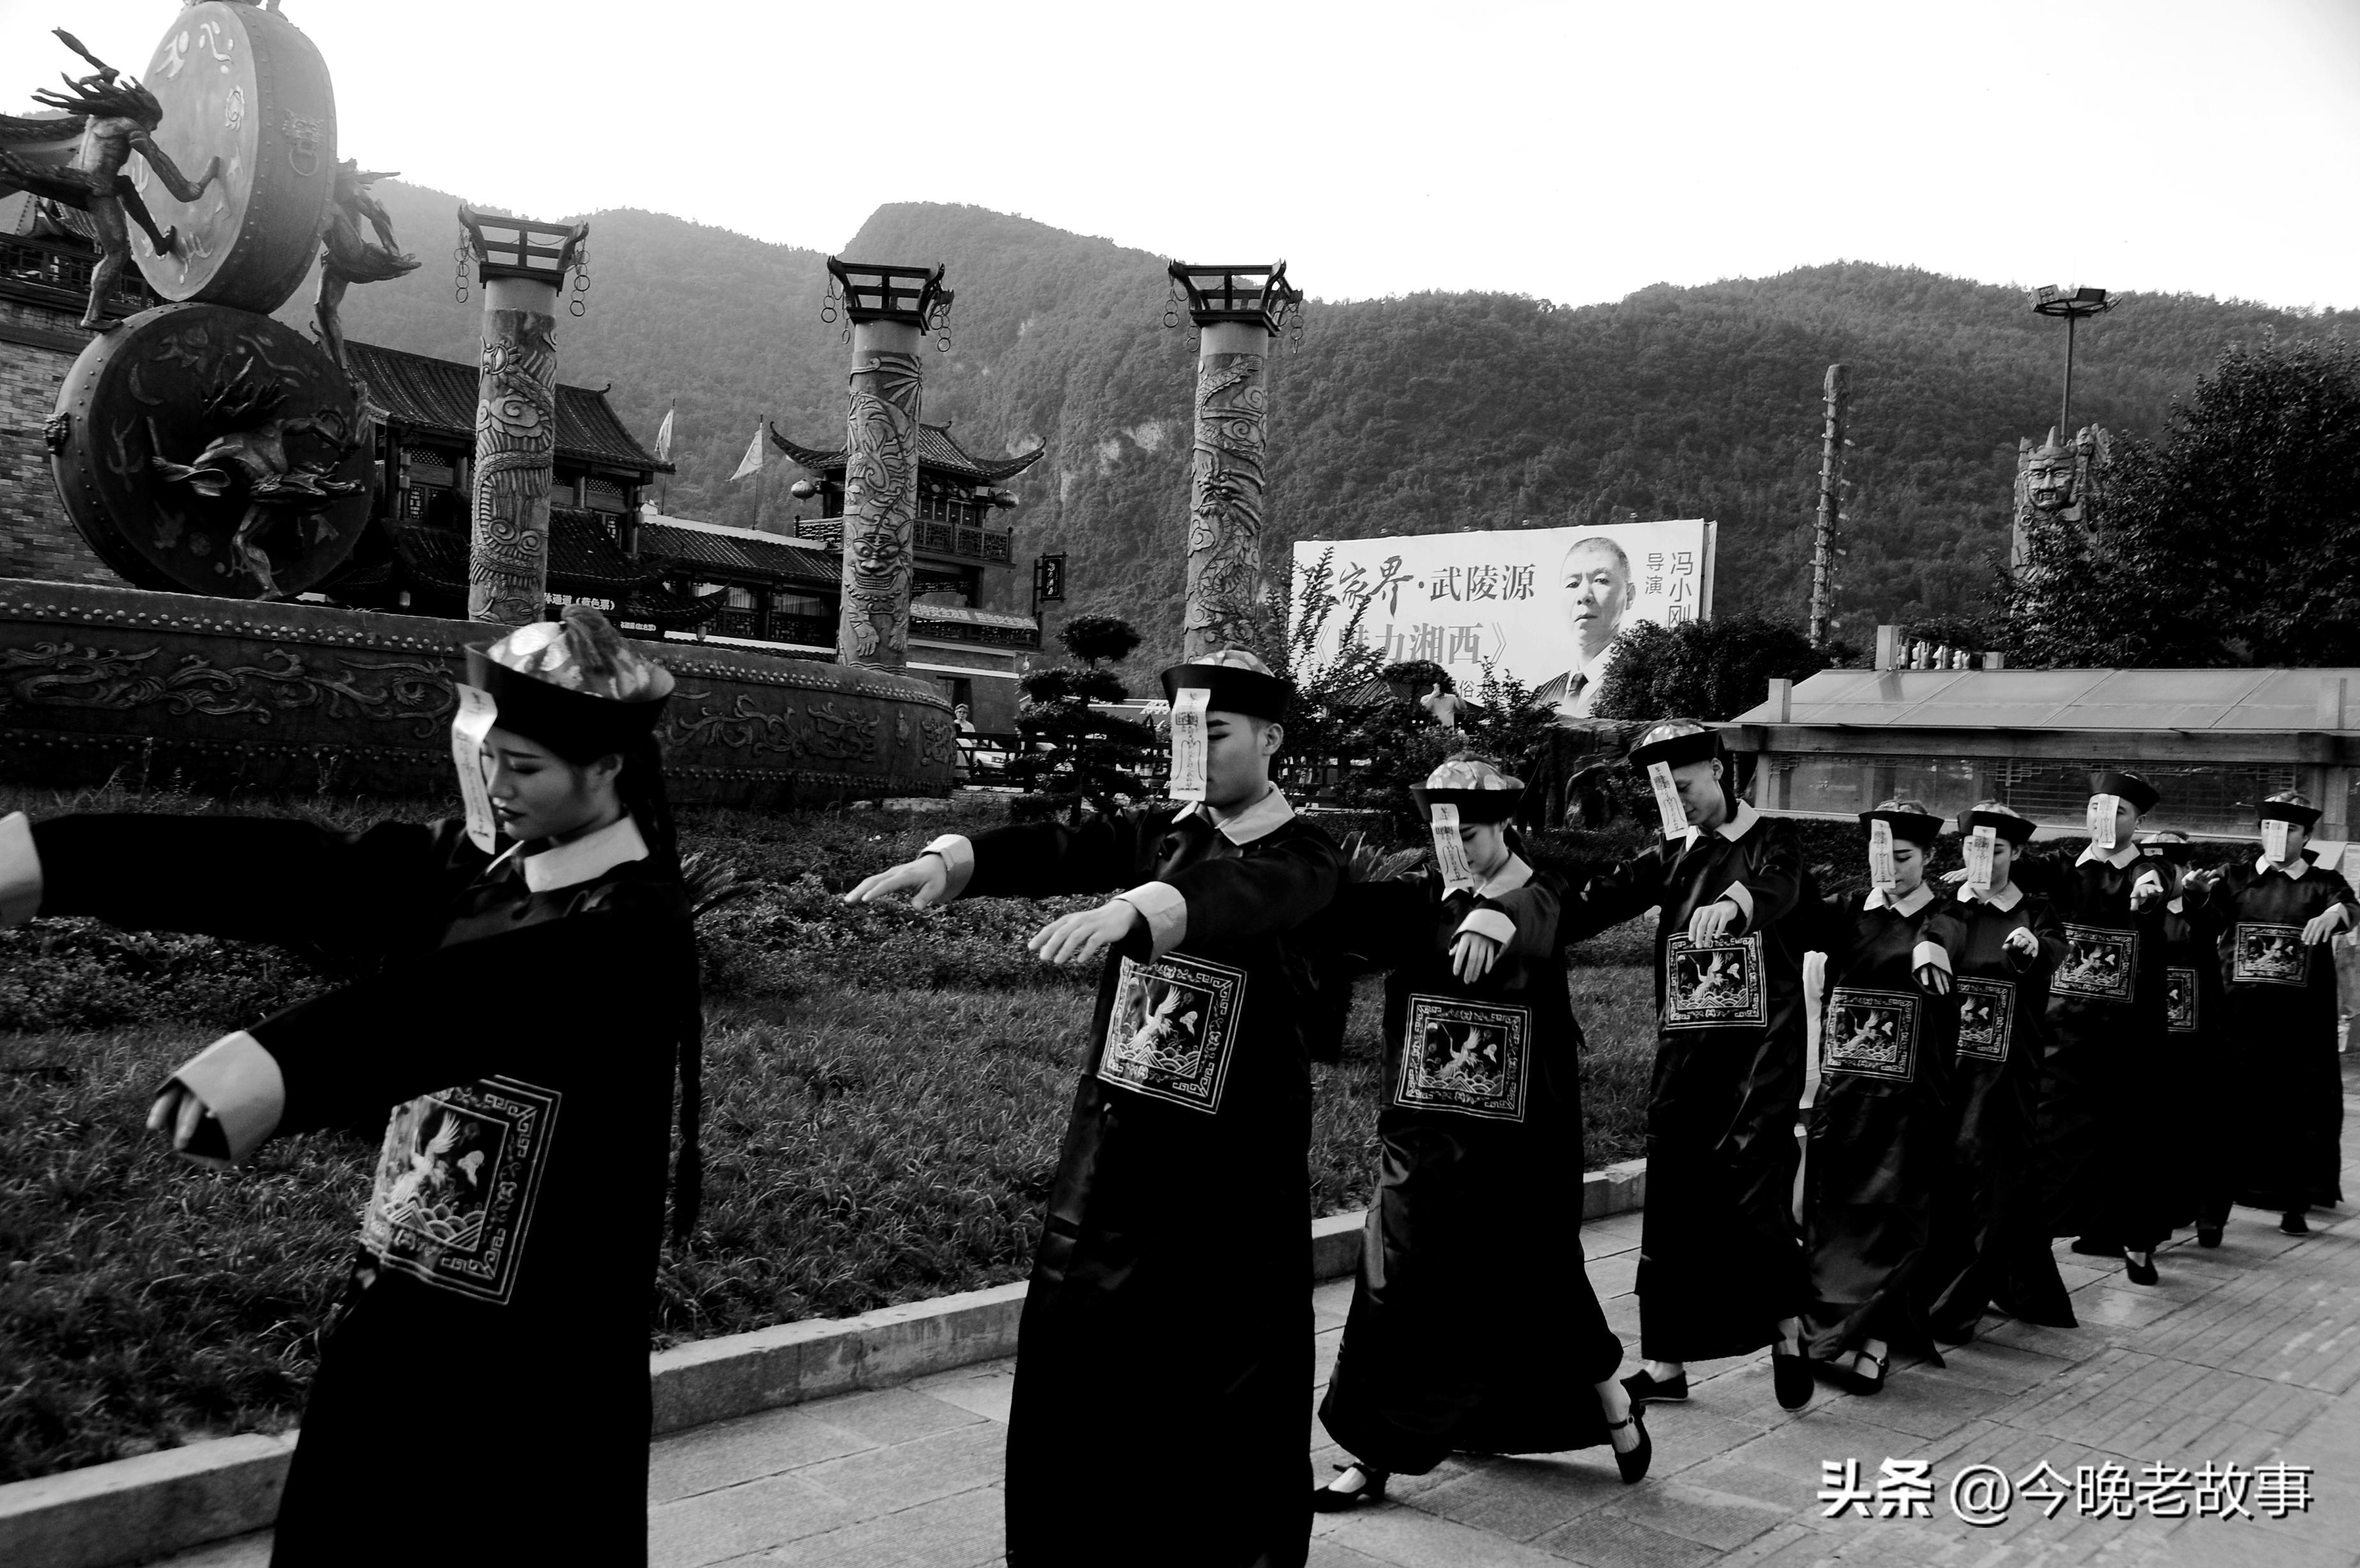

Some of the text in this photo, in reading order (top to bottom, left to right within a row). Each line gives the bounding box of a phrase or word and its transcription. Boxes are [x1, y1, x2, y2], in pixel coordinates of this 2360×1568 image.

[1645, 552, 1664, 594] 导演
[1669, 552, 1693, 628] 冯小刚
